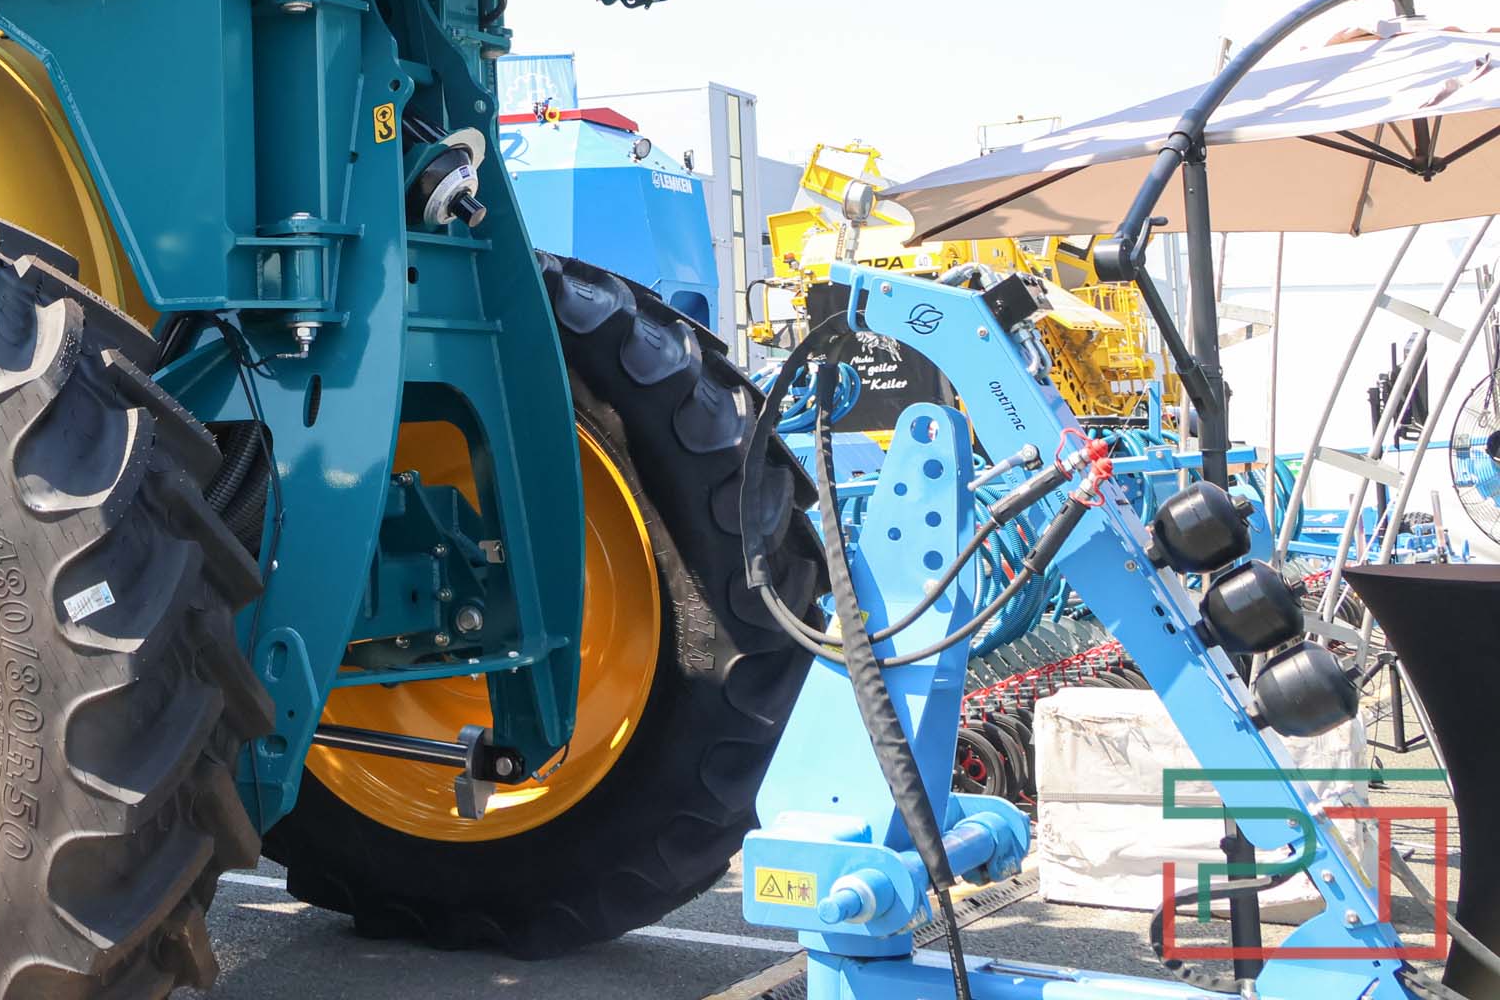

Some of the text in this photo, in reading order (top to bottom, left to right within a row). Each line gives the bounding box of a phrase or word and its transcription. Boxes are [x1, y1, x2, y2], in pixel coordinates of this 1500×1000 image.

[660, 173, 693, 194] LEMKEN
[868, 362, 897, 376] geiler
[870, 378, 908, 390] Keiler
[989, 381, 1025, 431] OptiTrac
